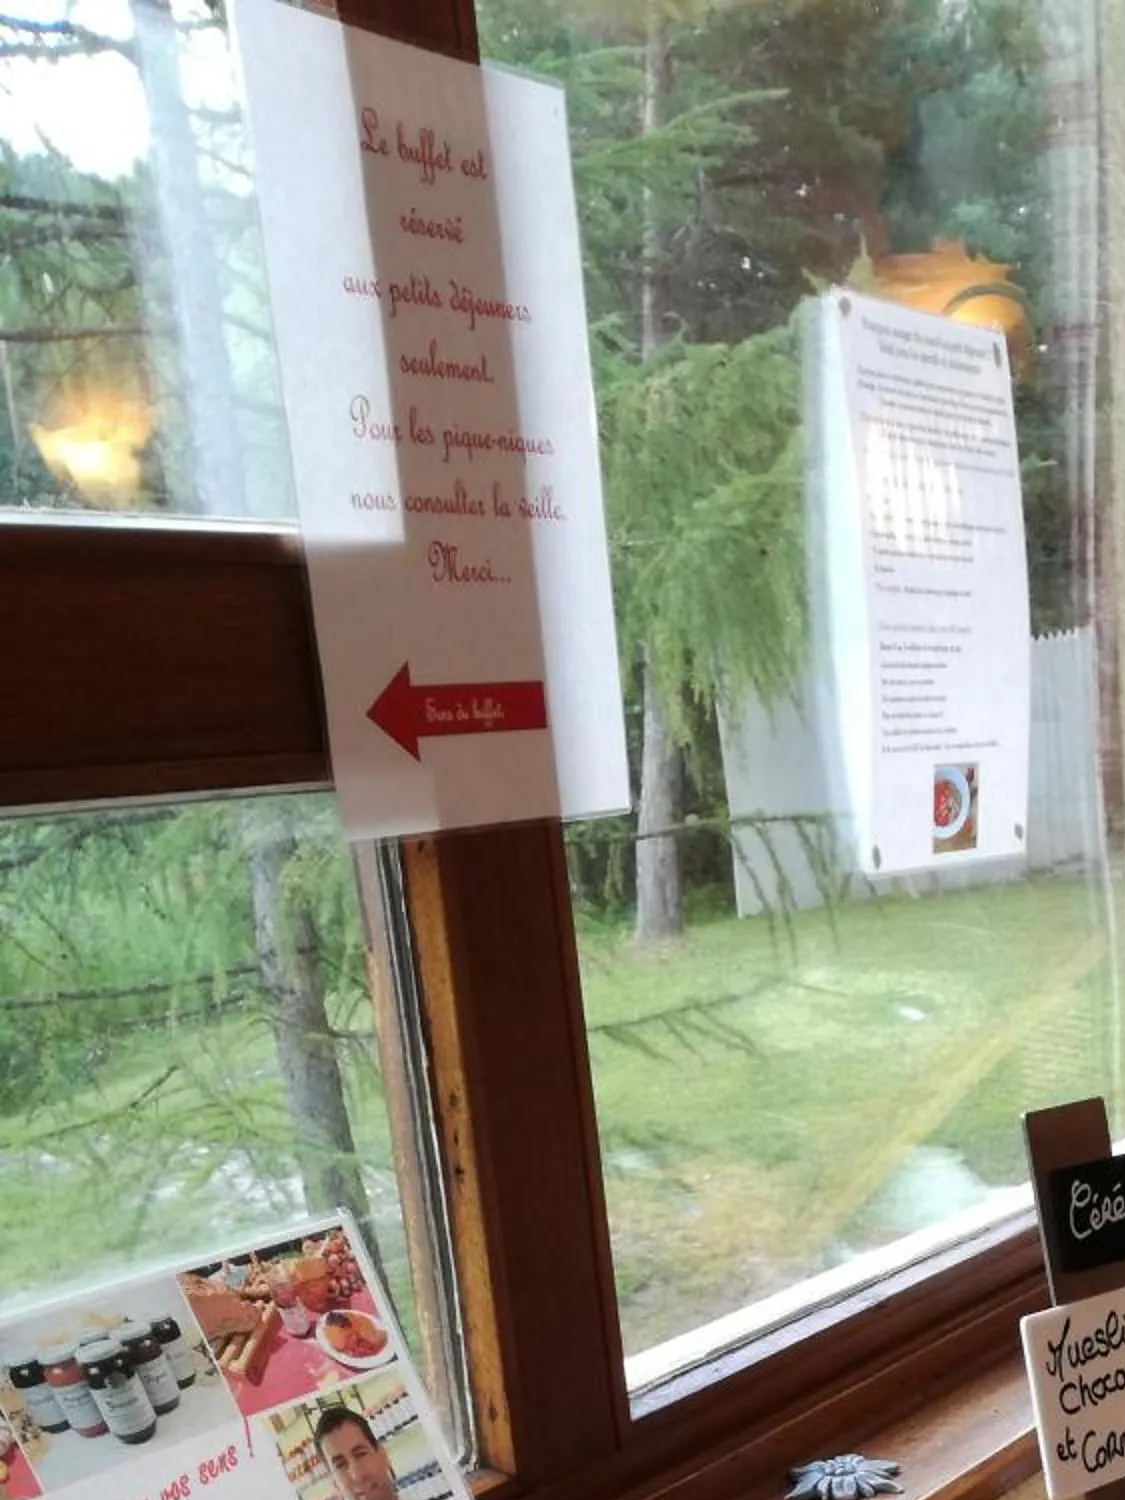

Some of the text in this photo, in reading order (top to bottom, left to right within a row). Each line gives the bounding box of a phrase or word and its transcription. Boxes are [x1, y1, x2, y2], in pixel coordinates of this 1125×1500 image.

[360, 106, 488, 186] Le buffet est
[400, 207, 465, 243] réservé
[343, 275, 531, 330] aux petits déjeuners
[350, 395, 555, 467] Pour les pique-niques
[351, 491, 397, 510] nous
[405, 479, 485, 518] consulter
[493, 490, 511, 518] la
[1057, 1426, 1078, 1461] et
[199, 1447, 240, 1486] sens
